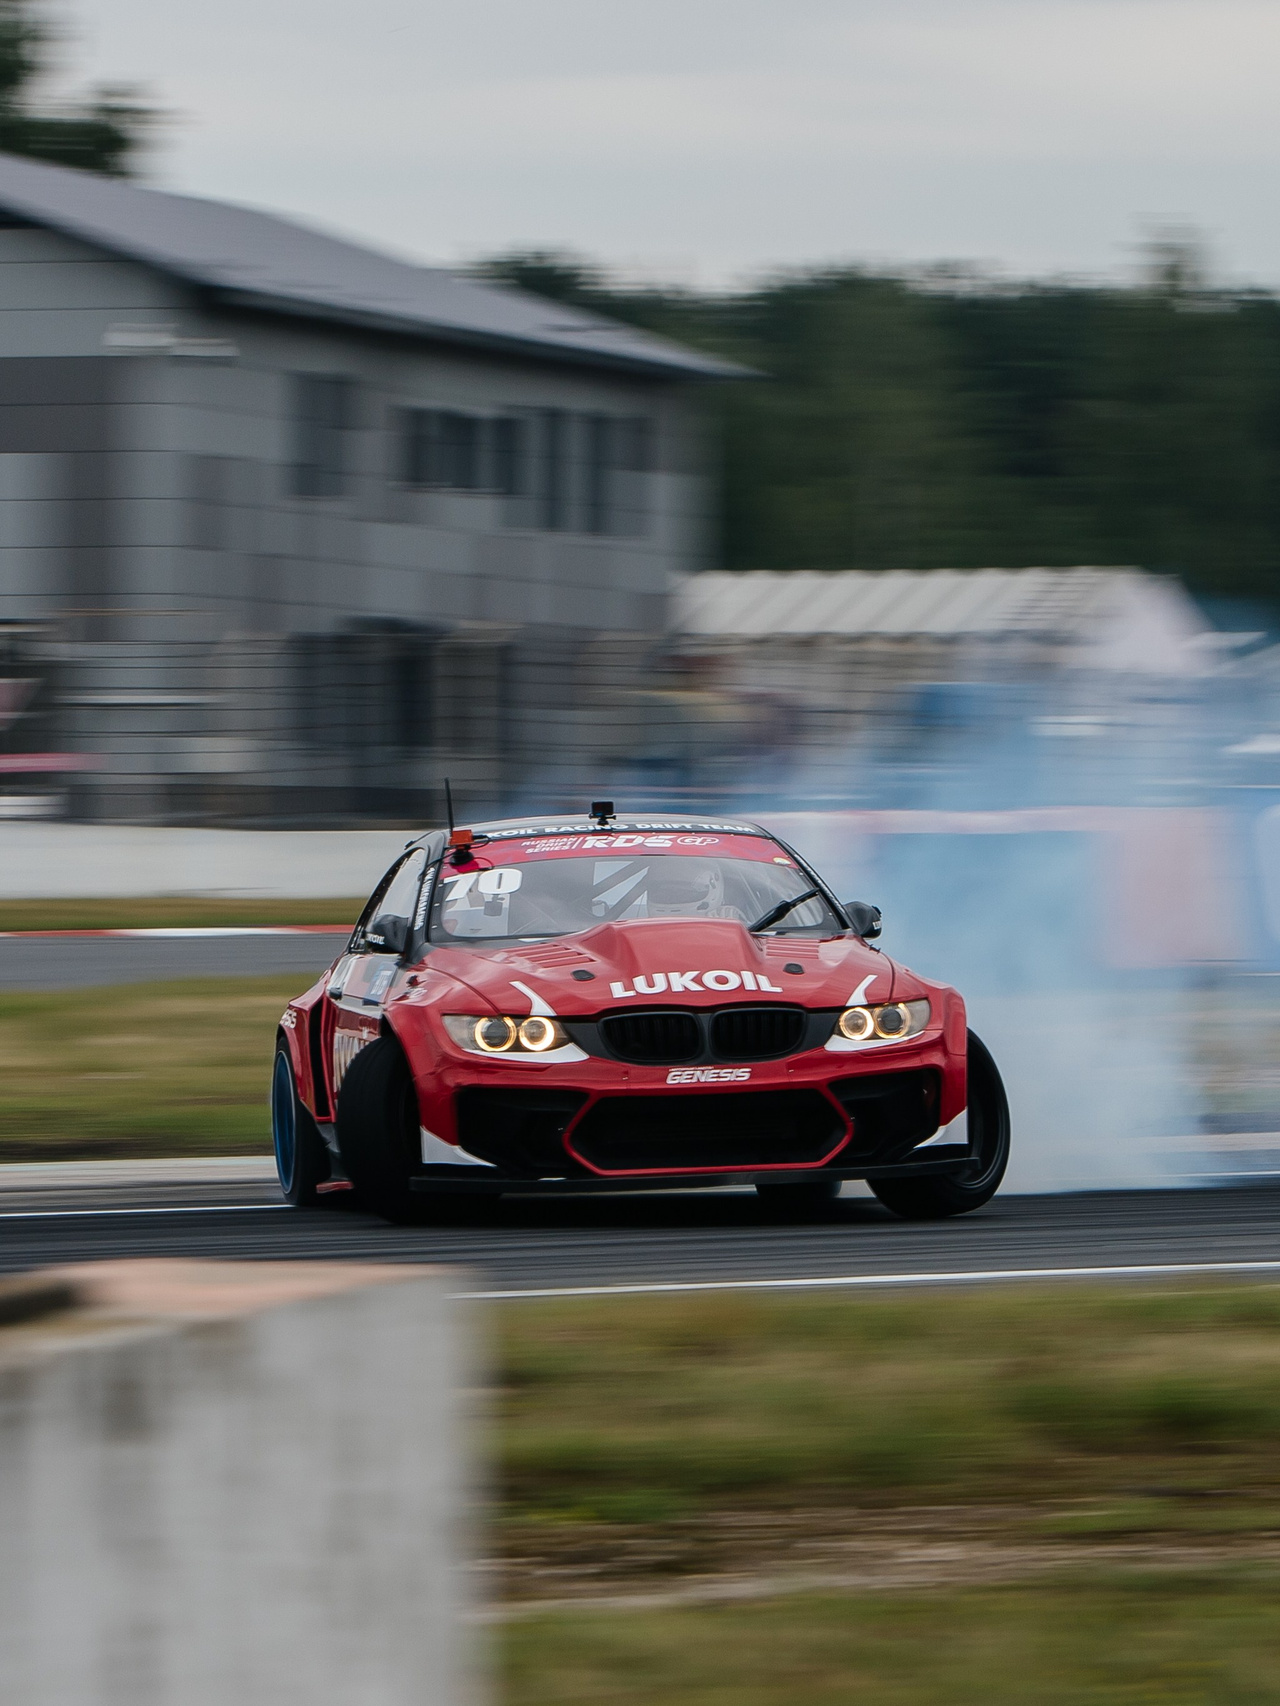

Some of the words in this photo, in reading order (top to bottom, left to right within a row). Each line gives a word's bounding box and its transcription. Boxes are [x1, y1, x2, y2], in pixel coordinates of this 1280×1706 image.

[486, 828, 539, 839] KOIL
[544, 824, 628, 834] RACING
[635, 823, 695, 831] DRIFT
[697, 823, 756, 833] TEAM
[521, 837, 578, 847] RUSSIAN
[525, 845, 571, 854] SERIES
[581, 834, 678, 849] RDS
[679, 836, 718, 847] GP
[443, 868, 523, 902] 70
[609, 969, 783, 999] LUKOIL
[665, 1067, 752, 1085] GENESIS
